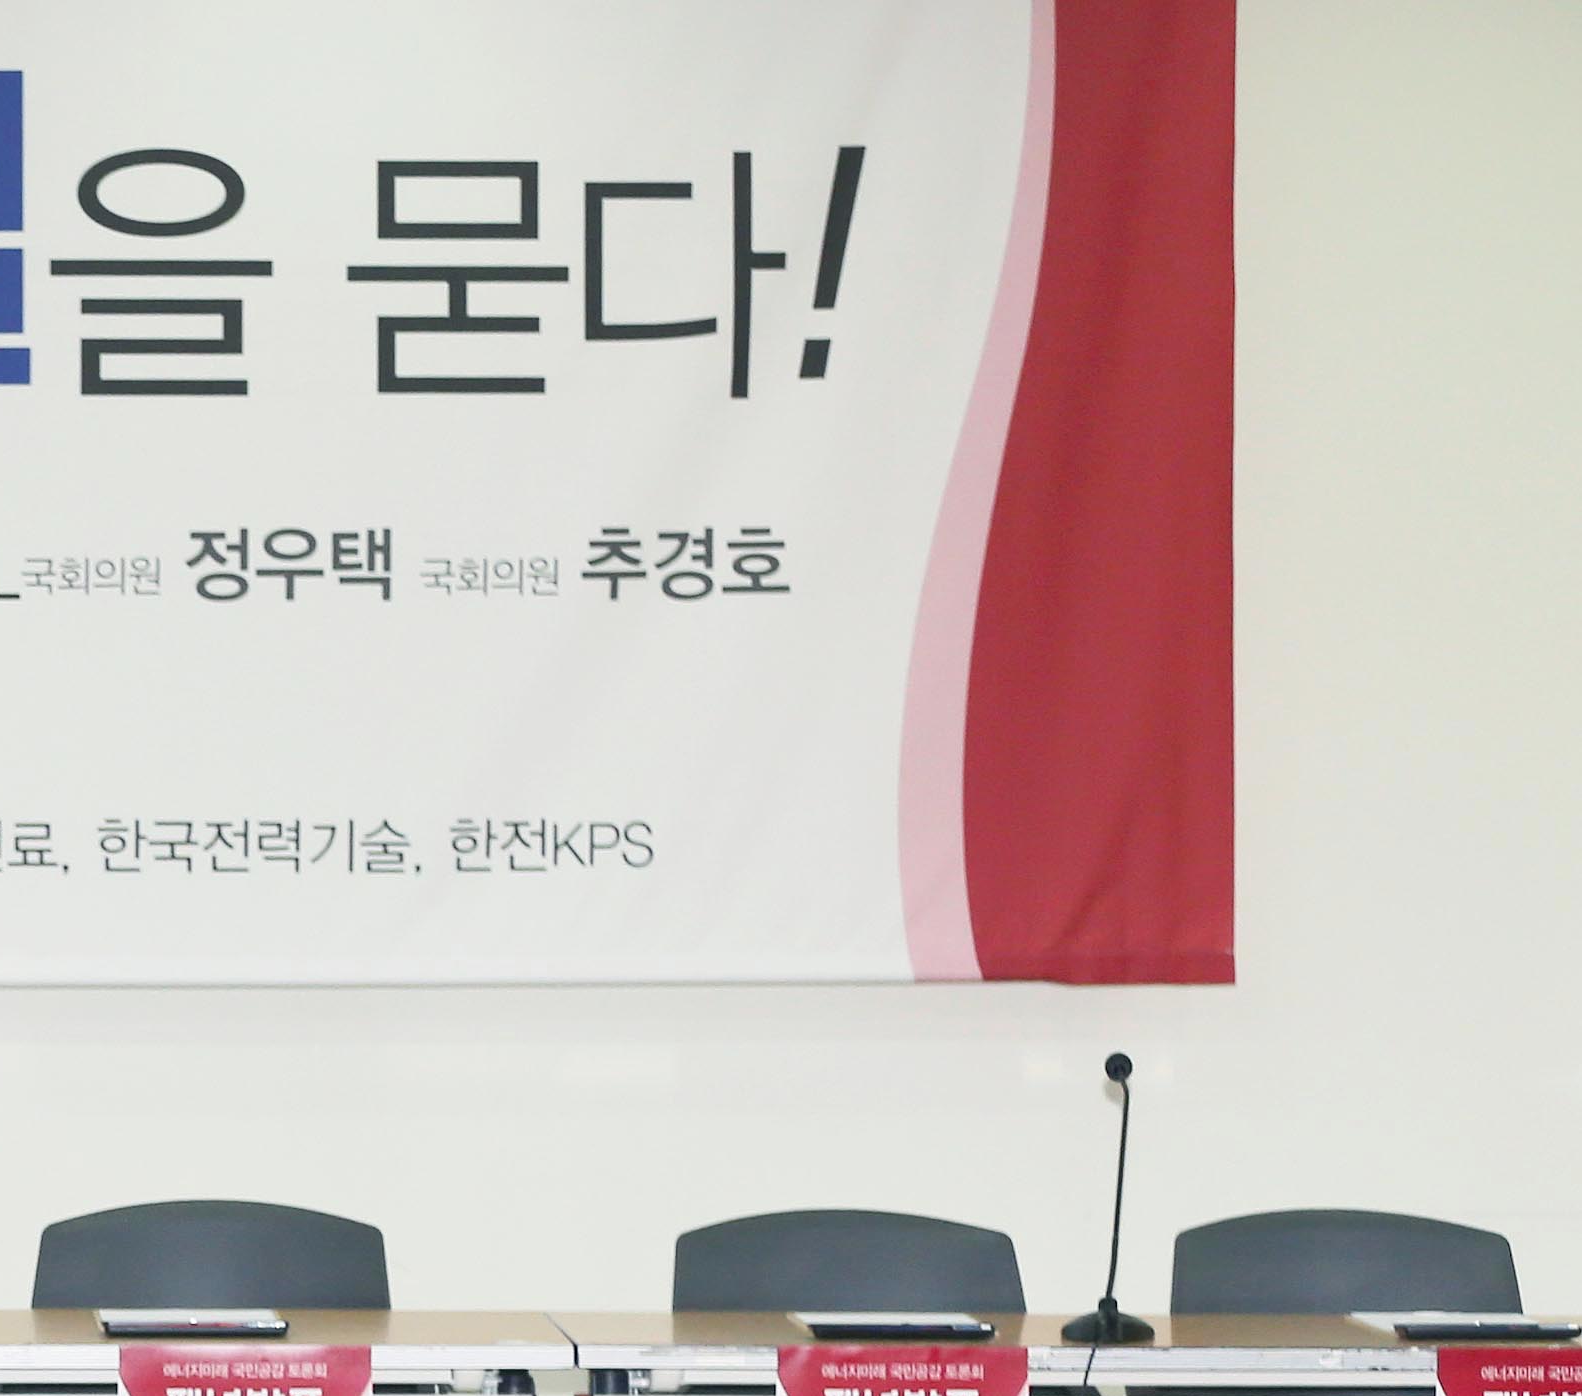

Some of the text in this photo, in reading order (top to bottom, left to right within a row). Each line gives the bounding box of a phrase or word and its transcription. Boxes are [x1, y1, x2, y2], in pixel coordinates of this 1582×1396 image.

[346, 144, 867, 400] 묻다!
[185, 527, 392, 602] 정우택
[420, 557, 559, 597] 국회의원
[581, 527, 791, 602] 추경호
[98, 819, 422, 874] 한국전력기술,
[450, 818, 654, 873] 한전KPS
